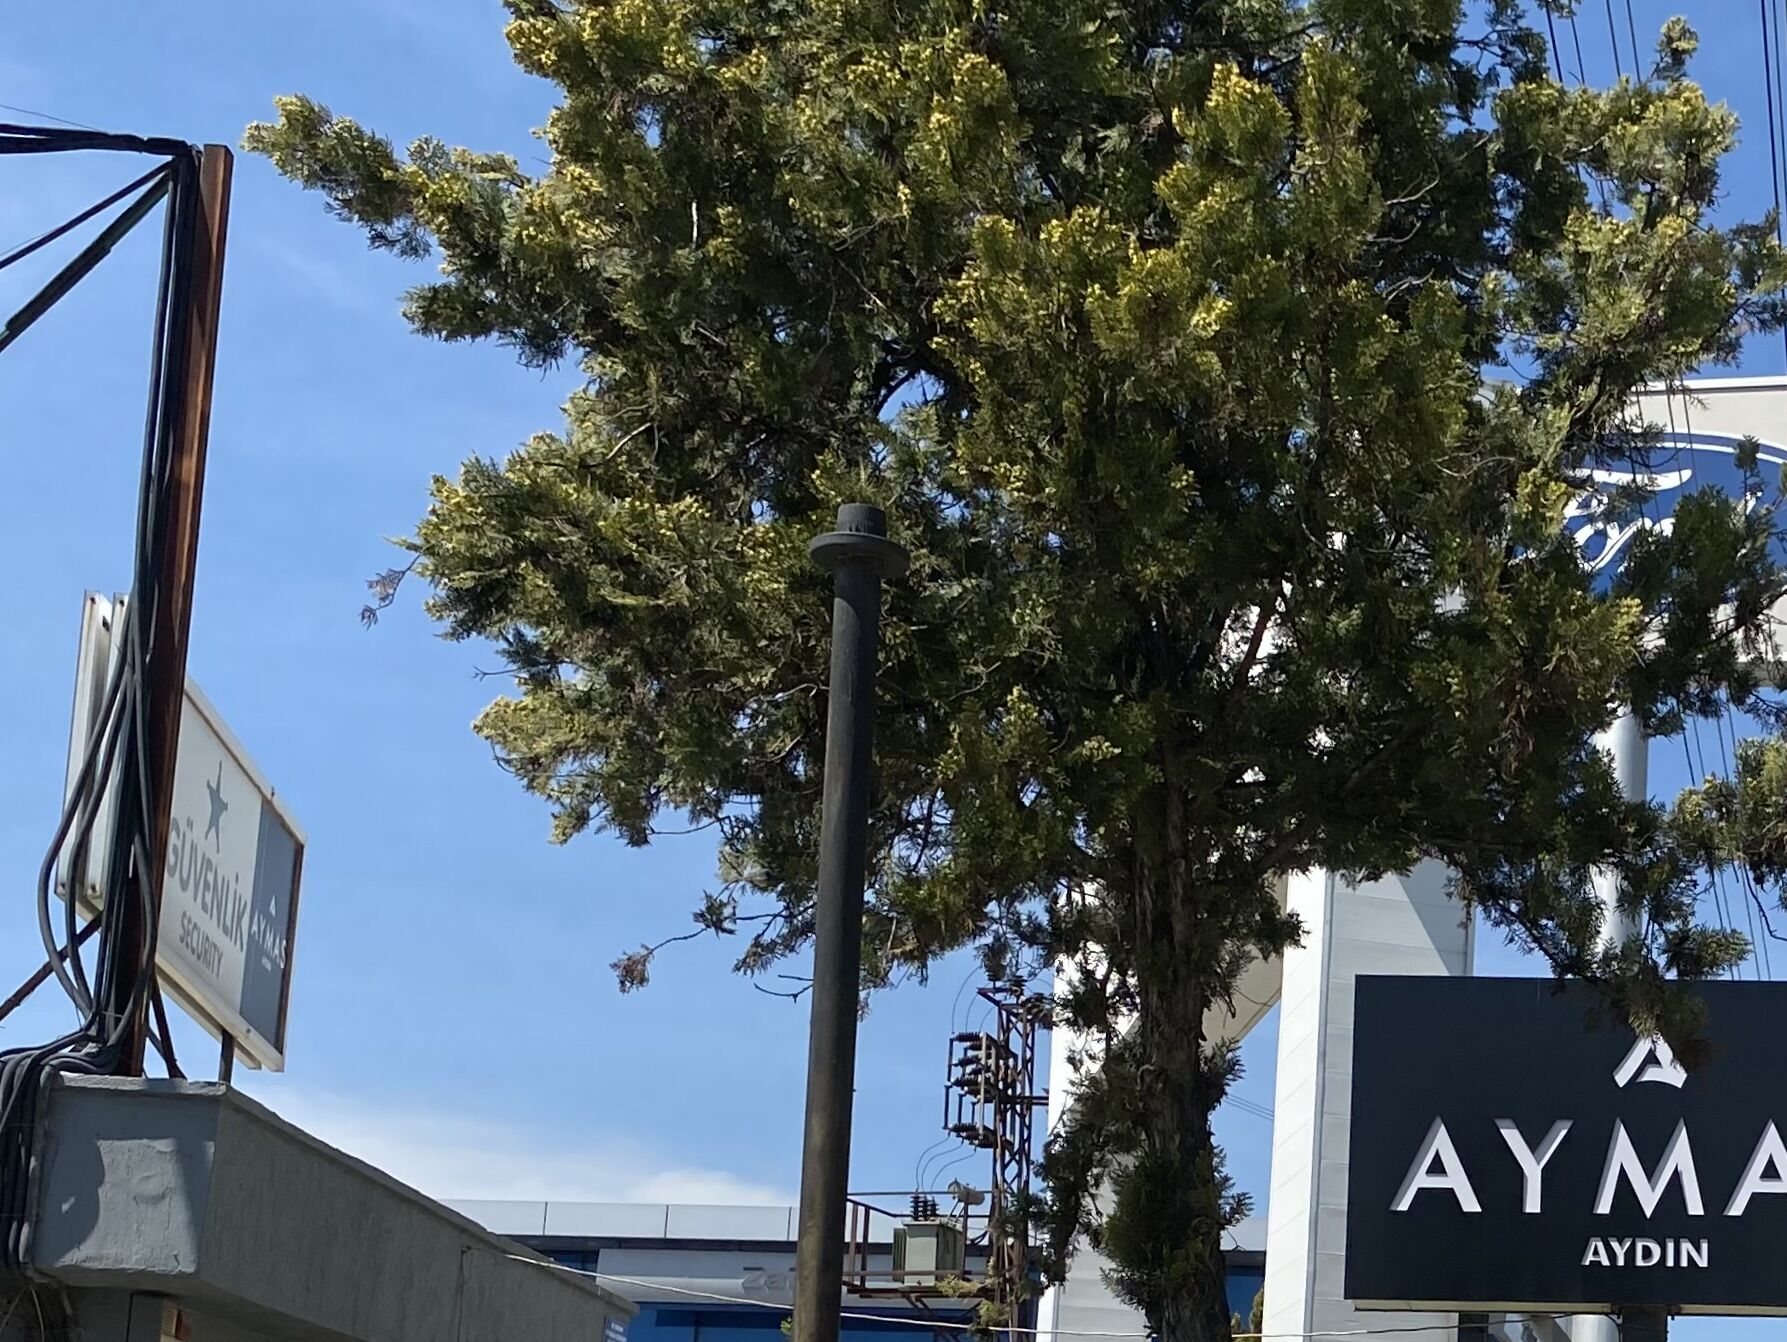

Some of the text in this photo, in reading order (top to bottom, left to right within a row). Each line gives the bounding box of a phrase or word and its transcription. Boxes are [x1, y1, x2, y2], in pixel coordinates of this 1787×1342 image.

[167, 815, 248, 952] GÜVENLİK
[179, 910, 224, 979] SECURITY
[251, 910, 287, 969] AYMAS
[1581, 1237, 1709, 1268] AYDIN
